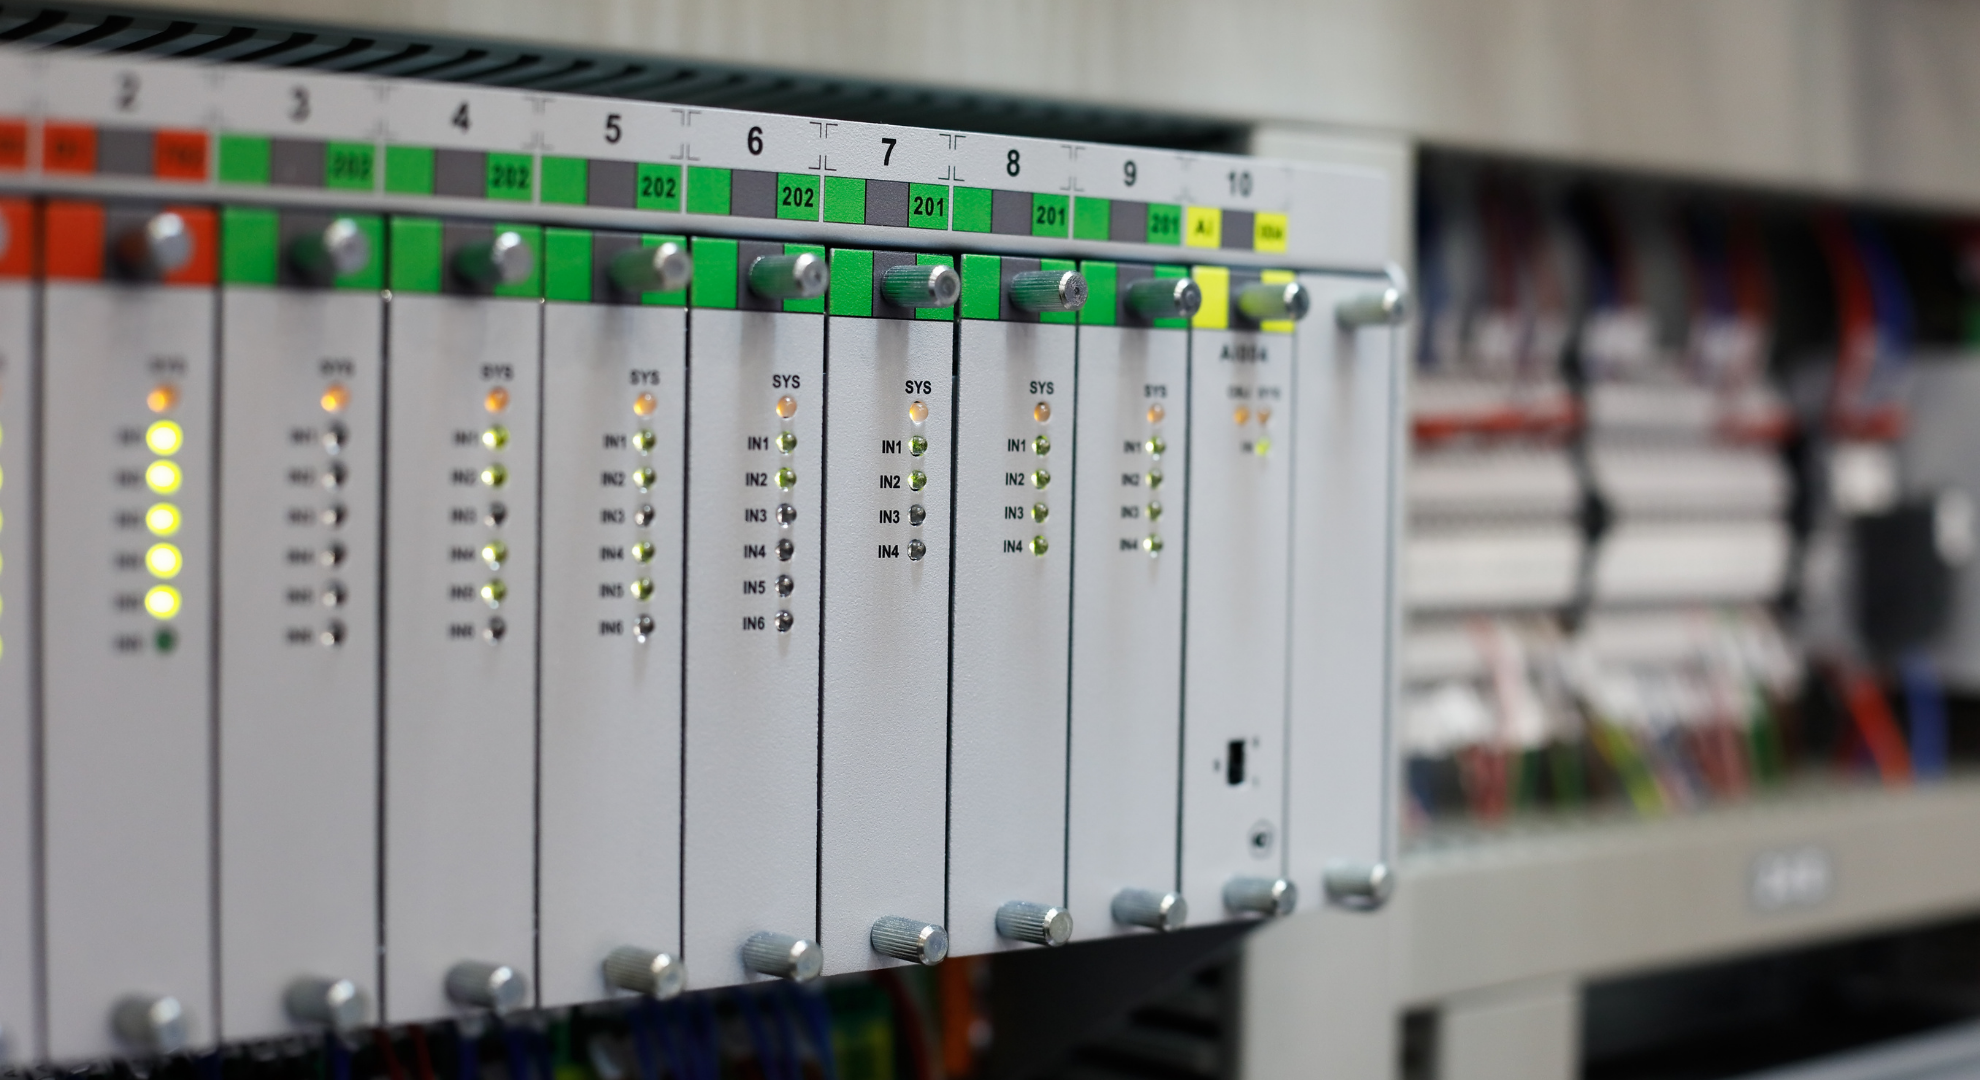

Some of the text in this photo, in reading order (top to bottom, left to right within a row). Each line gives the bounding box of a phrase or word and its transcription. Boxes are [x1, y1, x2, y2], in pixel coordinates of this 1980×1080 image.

[290, 86, 310, 122] 3
[451, 102, 471, 133] 4
[605, 114, 621, 144] 5
[748, 126, 763, 155] 6
[882, 138, 896, 166] 7
[1007, 149, 1020, 177] 8
[490, 164, 529, 190] 202
[1124, 160, 1137, 187] 9
[642, 176, 675, 198] 202
[1228, 171, 1253, 197] 10
[783, 187, 813, 207] 202
[914, 196, 943, 216] 201
[1037, 206, 1064, 225] 201
[1151, 214, 1178, 233] 201
[481, 364, 513, 380] SYS
[630, 369, 660, 385] SYS
[773, 375, 800, 389] SYS
[905, 380, 931, 394] SYS
[1030, 381, 1054, 394] SYS
[1144, 384, 1166, 397] SYS
[604, 434, 626, 448] IN1
[748, 437, 768, 450] IN1
[882, 440, 901, 454] IN1
[1008, 439, 1025, 452] IN1
[1124, 441, 1141, 452] IN1
[601, 472, 624, 486] IN2
[746, 473, 767, 486] IN2
[880, 475, 900, 488] IN2
[1006, 473, 1024, 485] IN2
[1122, 474, 1139, 486] IN2
[601, 510, 624, 523] IN3
[745, 509, 767, 522] IN3
[880, 510, 899, 523] IN3
[1005, 507, 1023, 519] IN3
[1121, 507, 1138, 518] IN3
[744, 545, 766, 558] IN4
[879, 545, 899, 558] IN4
[1004, 540, 1022, 552] IN4
[1120, 539, 1137, 550] IN4
[600, 547, 623, 561] IN4
[600, 584, 623, 598] IN5
[744, 581, 765, 594] IN5
[600, 621, 622, 635] IN6
[743, 617, 765, 630] IN6
